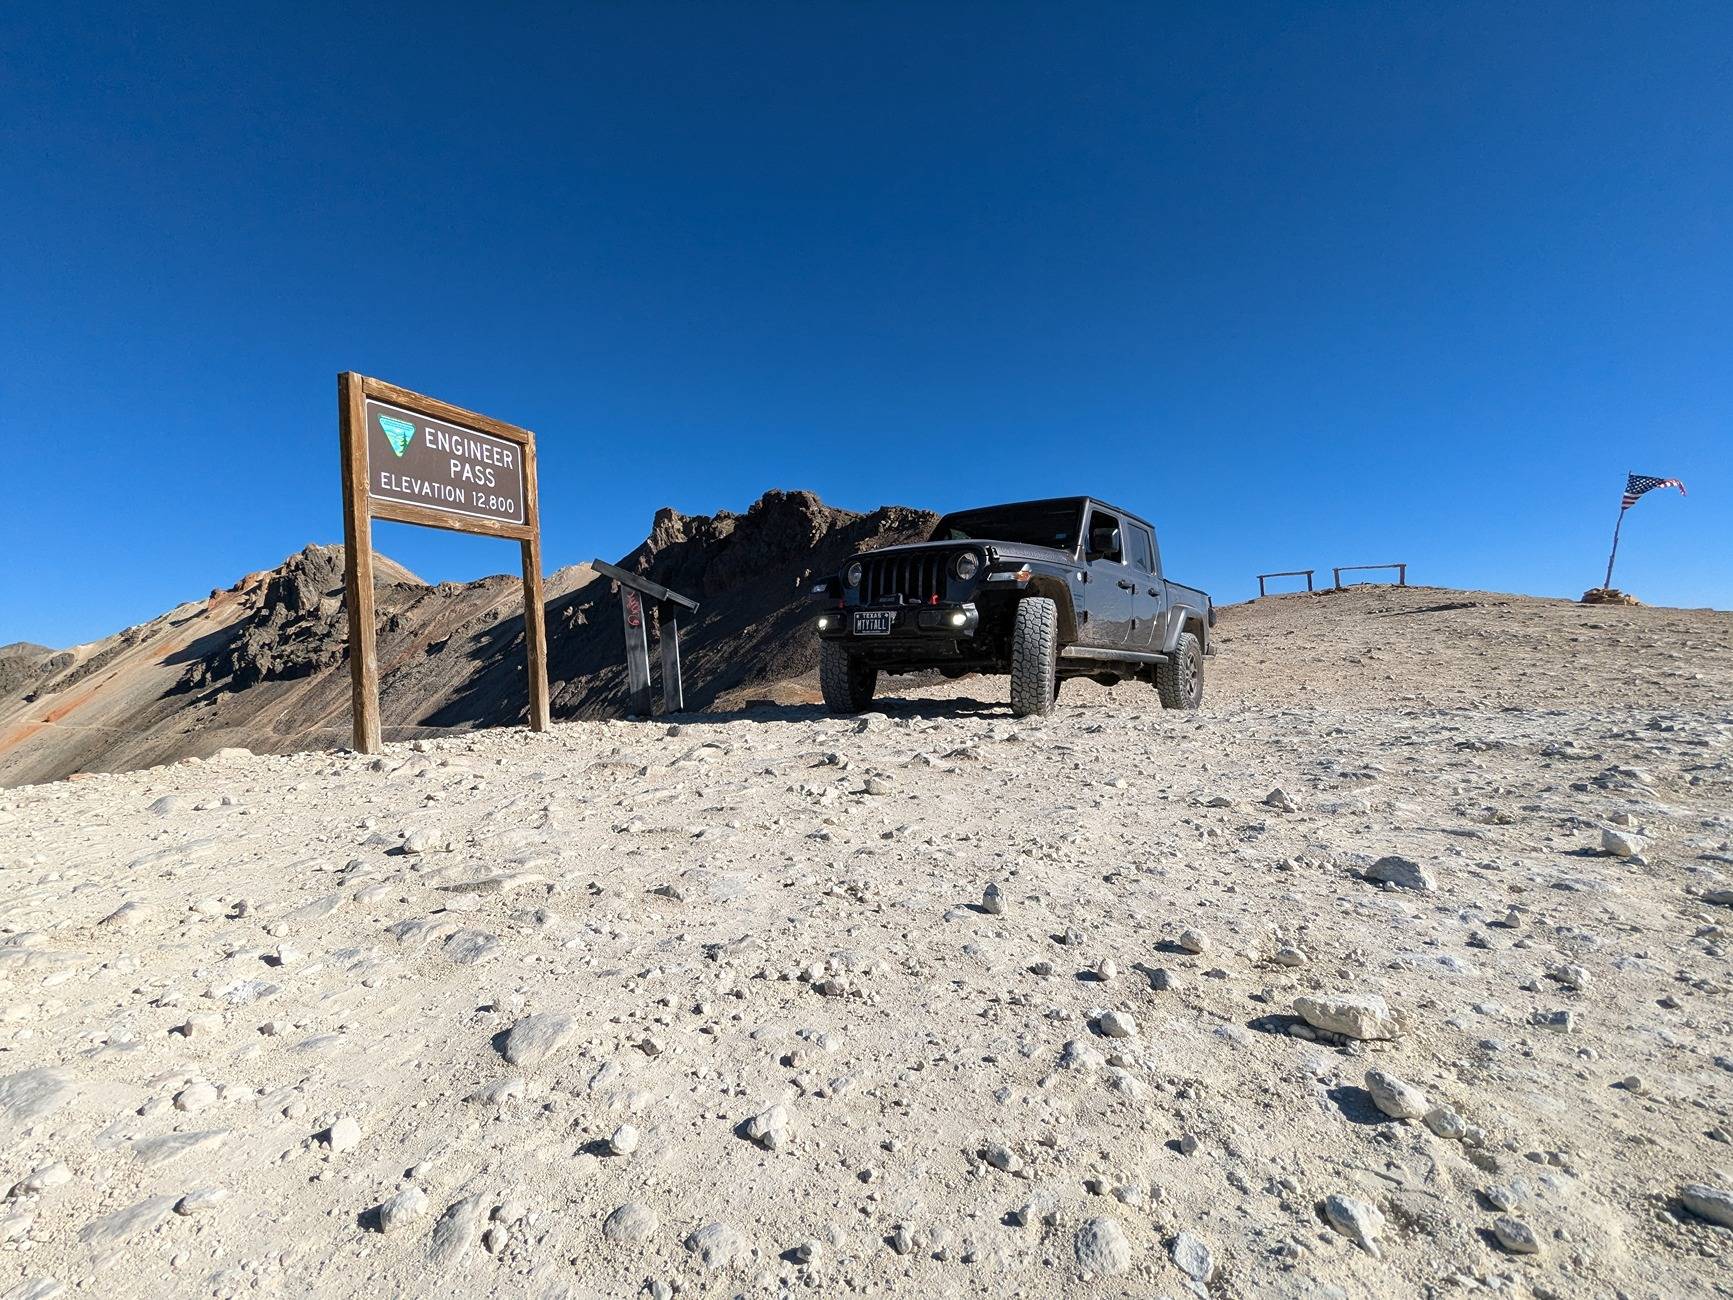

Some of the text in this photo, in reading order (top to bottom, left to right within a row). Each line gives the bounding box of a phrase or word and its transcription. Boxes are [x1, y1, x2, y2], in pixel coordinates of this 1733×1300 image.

[424, 427, 513, 470] ENGINEER
[380, 471, 515, 514] ELEVATION 12,800
[450, 459, 496, 488] PASS
